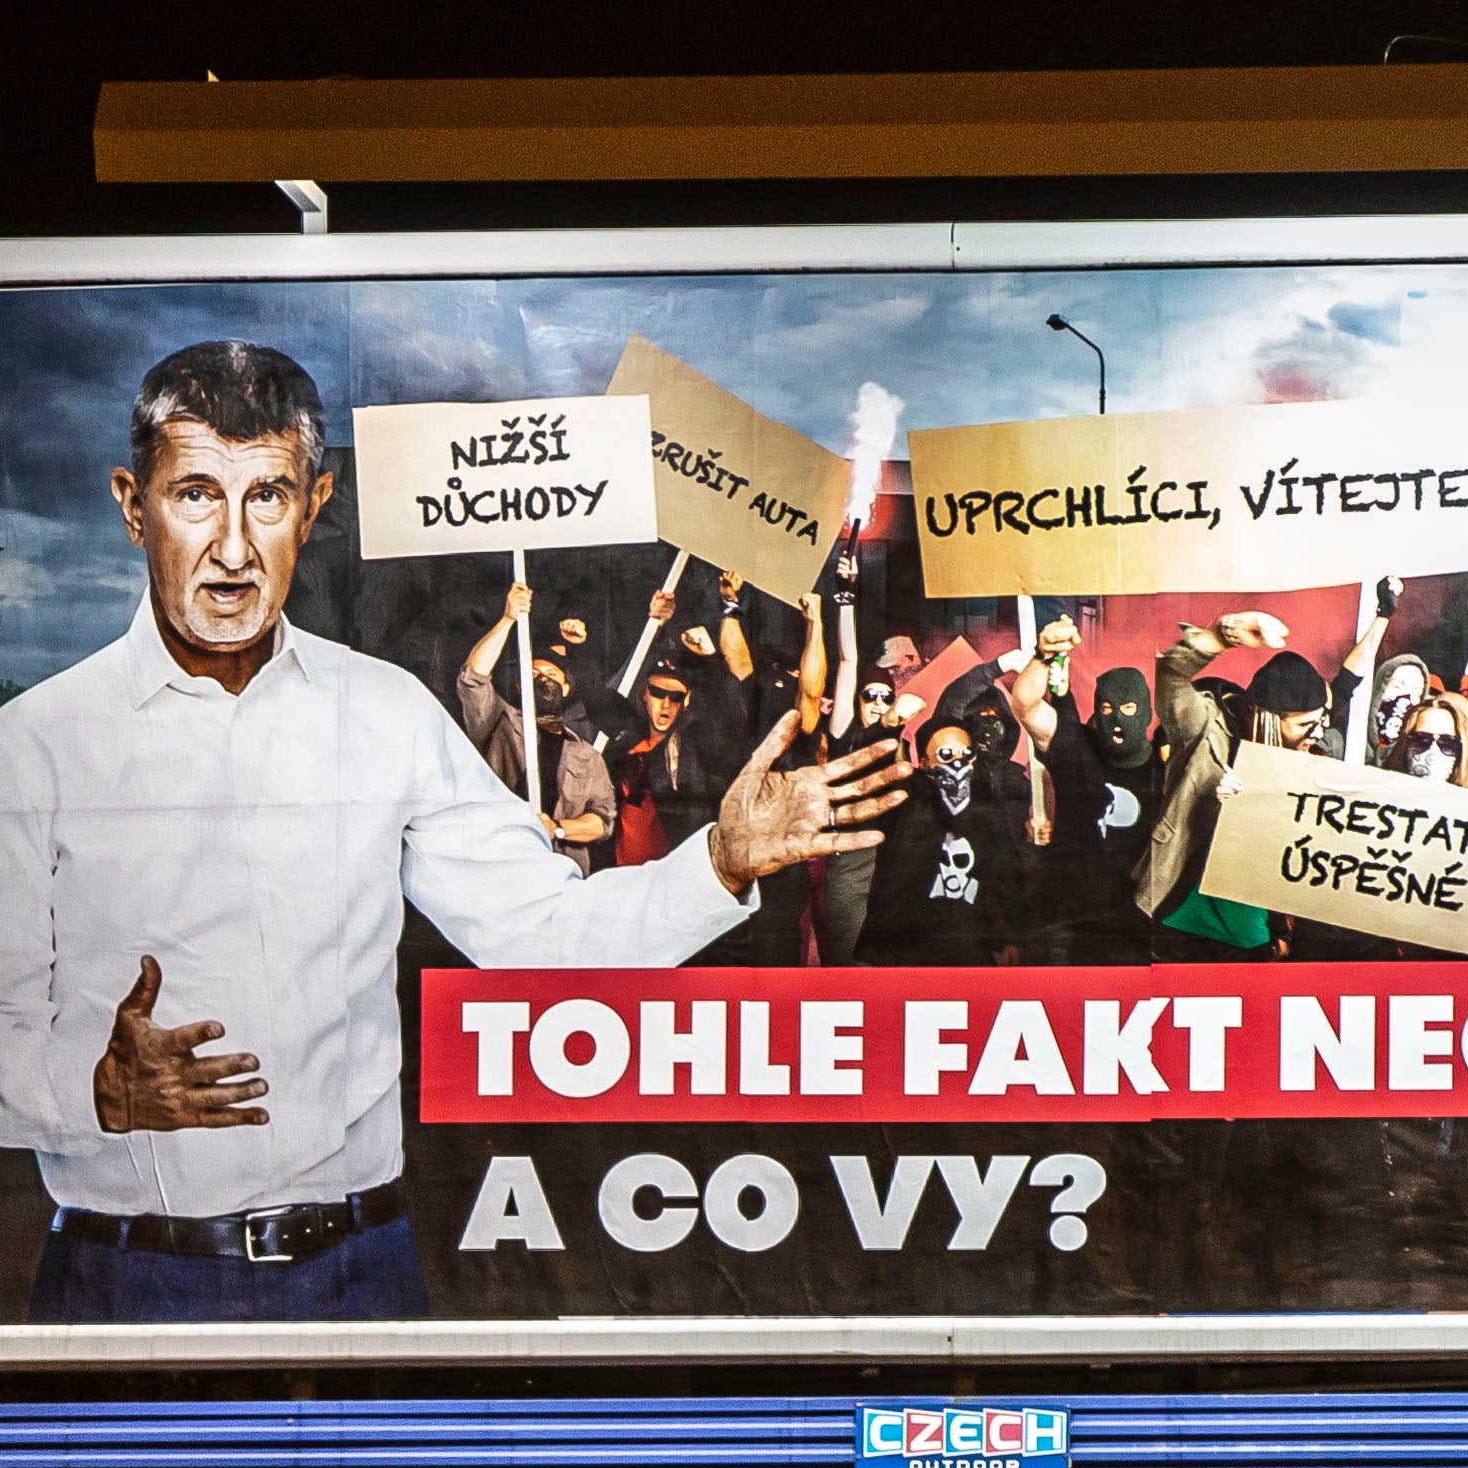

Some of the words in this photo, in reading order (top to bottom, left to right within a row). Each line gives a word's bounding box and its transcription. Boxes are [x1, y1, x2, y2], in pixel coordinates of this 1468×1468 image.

[449, 413, 572, 471] NIŽŠÍ
[415, 476, 610, 529] DŮCHODY
[650, 430, 750, 500] ZRUŠIT
[748, 491, 820, 547] AUTA
[924, 464, 1222, 538] UPRCHLÍCI,
[1279, 834, 1468, 912] ÚSPĚŠNÉ
[461, 998, 864, 1098] TOHLE
[903, 996, 1243, 1096] FAKT
[458, 1155, 566, 1251] A
[597, 1152, 800, 1252] CO
[829, 1153, 1107, 1252] VY?
[868, 1412, 1063, 1453] CZECH
